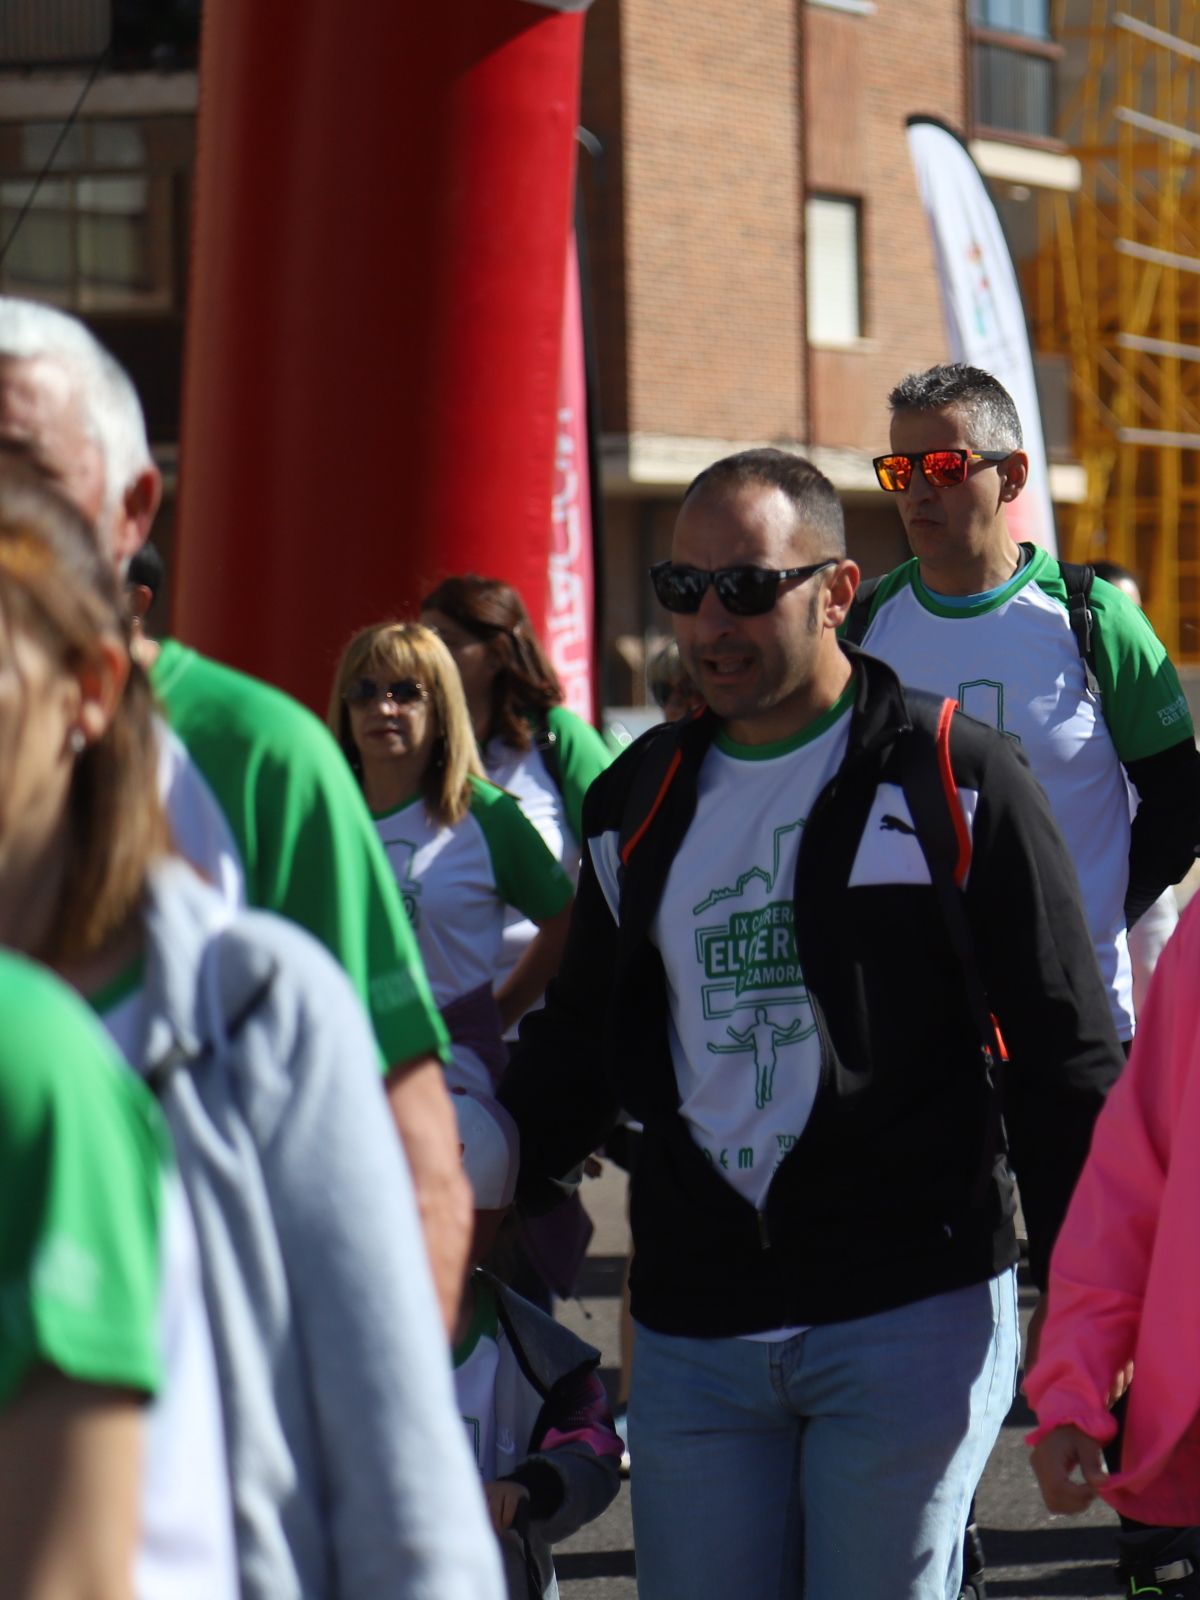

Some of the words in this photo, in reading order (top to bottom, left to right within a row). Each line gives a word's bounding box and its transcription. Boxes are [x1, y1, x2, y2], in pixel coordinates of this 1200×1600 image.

[735, 918, 749, 936] IX
[710, 940, 741, 974] EL
[745, 964, 803, 986] ZAMORA
